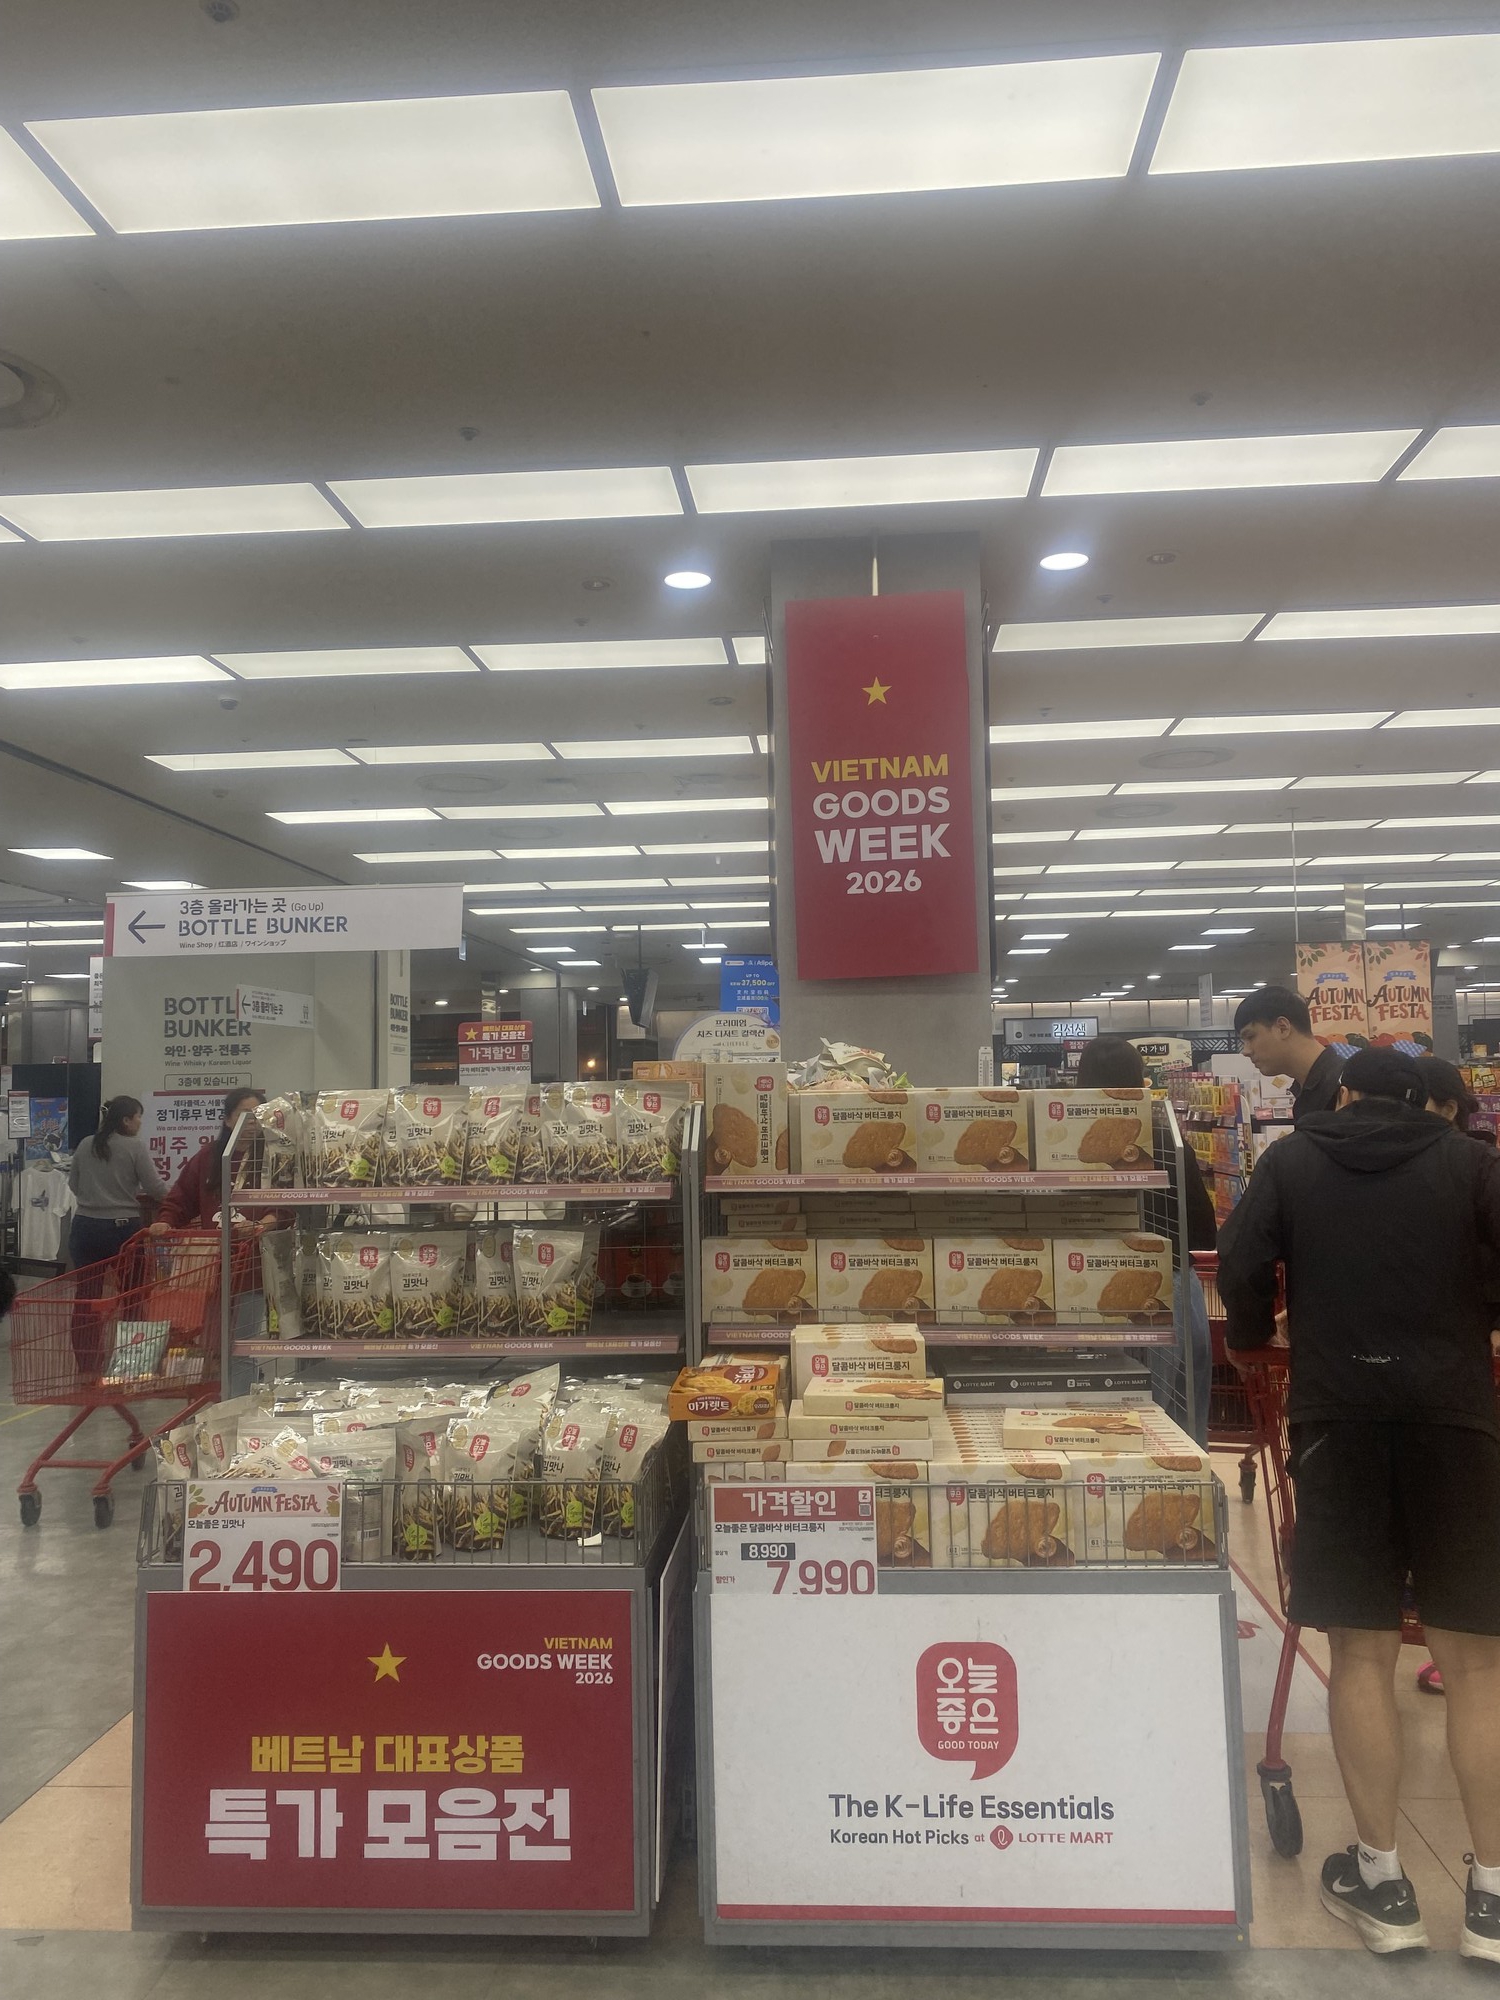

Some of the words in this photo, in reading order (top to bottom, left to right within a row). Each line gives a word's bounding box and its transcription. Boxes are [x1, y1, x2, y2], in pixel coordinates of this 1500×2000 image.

[811, 754, 949, 783] VIETNAM
[812, 786, 951, 820] GOODS
[814, 823, 951, 864] WEEK
[845, 869, 922, 895] 2026
[179, 900, 204, 916] 3층
[207, 898, 269, 915] 올라가는
[271, 898, 287, 914] 곳
[291, 902, 306, 913] (Go
[308, 901, 324, 912] Up)
[179, 918, 257, 937] BOTTLE
[267, 916, 349, 935] BUNKER
[741, 979, 767, 987] 37,500
[1306, 987, 1367, 1006] AUTUMN
[1367, 985, 1432, 1007] AUTUMN
[164, 997, 236, 1015] BOTTL
[1375, 1002, 1430, 1021] FESTA
[1309, 1004, 1365, 1024] FESTA
[164, 1018, 251, 1038] BUNKER
[1052, 1022, 1086, 1037] 김선생
[468, 1046, 516, 1060] 가격할인
[178, 1077, 200, 1087] 3층에
[203, 1076, 238, 1086] 있습니다
[156, 1109, 202, 1121] 정기휴무
[832, 1111, 863, 1120] 달콤바삭
[944, 1108, 974, 1118] 달콤바삭
[1067, 1106, 1098, 1117] 달콤바삭
[406, 1127, 433, 1138] 김맛나
[578, 1124, 603, 1134] 김맛나
[627, 1122, 653, 1133] 김맛나
[732, 1258, 763, 1267] 달콤바삭
[848, 1258, 880, 1267] 달콤바삭
[967, 1257, 998, 1266] 달콤바삭
[1086, 1259, 1118, 1268] 달콤바삭
[342, 1280, 369, 1290] 김맛나
[402, 1279, 429, 1288] 김맛나
[832, 1361, 866, 1371] 달콤바삭
[332, 1458, 353, 1468] 김맛나
[875, 1487, 911, 1499] 터크룽지
[208, 1490, 273, 1516] AUTUMN
[274, 1493, 321, 1513] FESTA
[742, 1490, 836, 1517] 가격할인
[187, 1520, 220, 1529] 오늘좋은
[221, 1519, 245, 1529] 김맛나
[714, 1523, 748, 1533] 오늘좋은
[749, 1523, 783, 1533] 달콤바삭
[749, 1544, 788, 1559] 8,990
[715, 1576, 736, 1584] 할인가
[766, 1559, 875, 1594] 7990
[544, 1637, 613, 1650] VIETNAM
[477, 1653, 552, 1670] GOODS
[556, 1653, 613, 1670] WEEK
[575, 1672, 613, 1685] 2026
[937, 1657, 998, 1694] 오늘
[937, 1697, 999, 1735] 좋은
[938, 1740, 965, 1750] GOOD
[968, 1740, 999, 1750] TODAY
[251, 1736, 365, 1774] 베트남
[375, 1736, 524, 1774] 대표상품
[828, 1794, 879, 1818] The
[885, 1794, 974, 1819] K-Life
[981, 1795, 1115, 1820] Essentials
[205, 1788, 344, 1861] 특가
[363, 1787, 572, 1861] 모음전
[830, 1829, 889, 1845] Korean
[892, 1829, 921, 1845] Hot
[925, 1829, 969, 1845] Picks
[974, 1833, 985, 1842] at
[1018, 1832, 1065, 1843] LOTTE
[1069, 1832, 1114, 1844] MART
